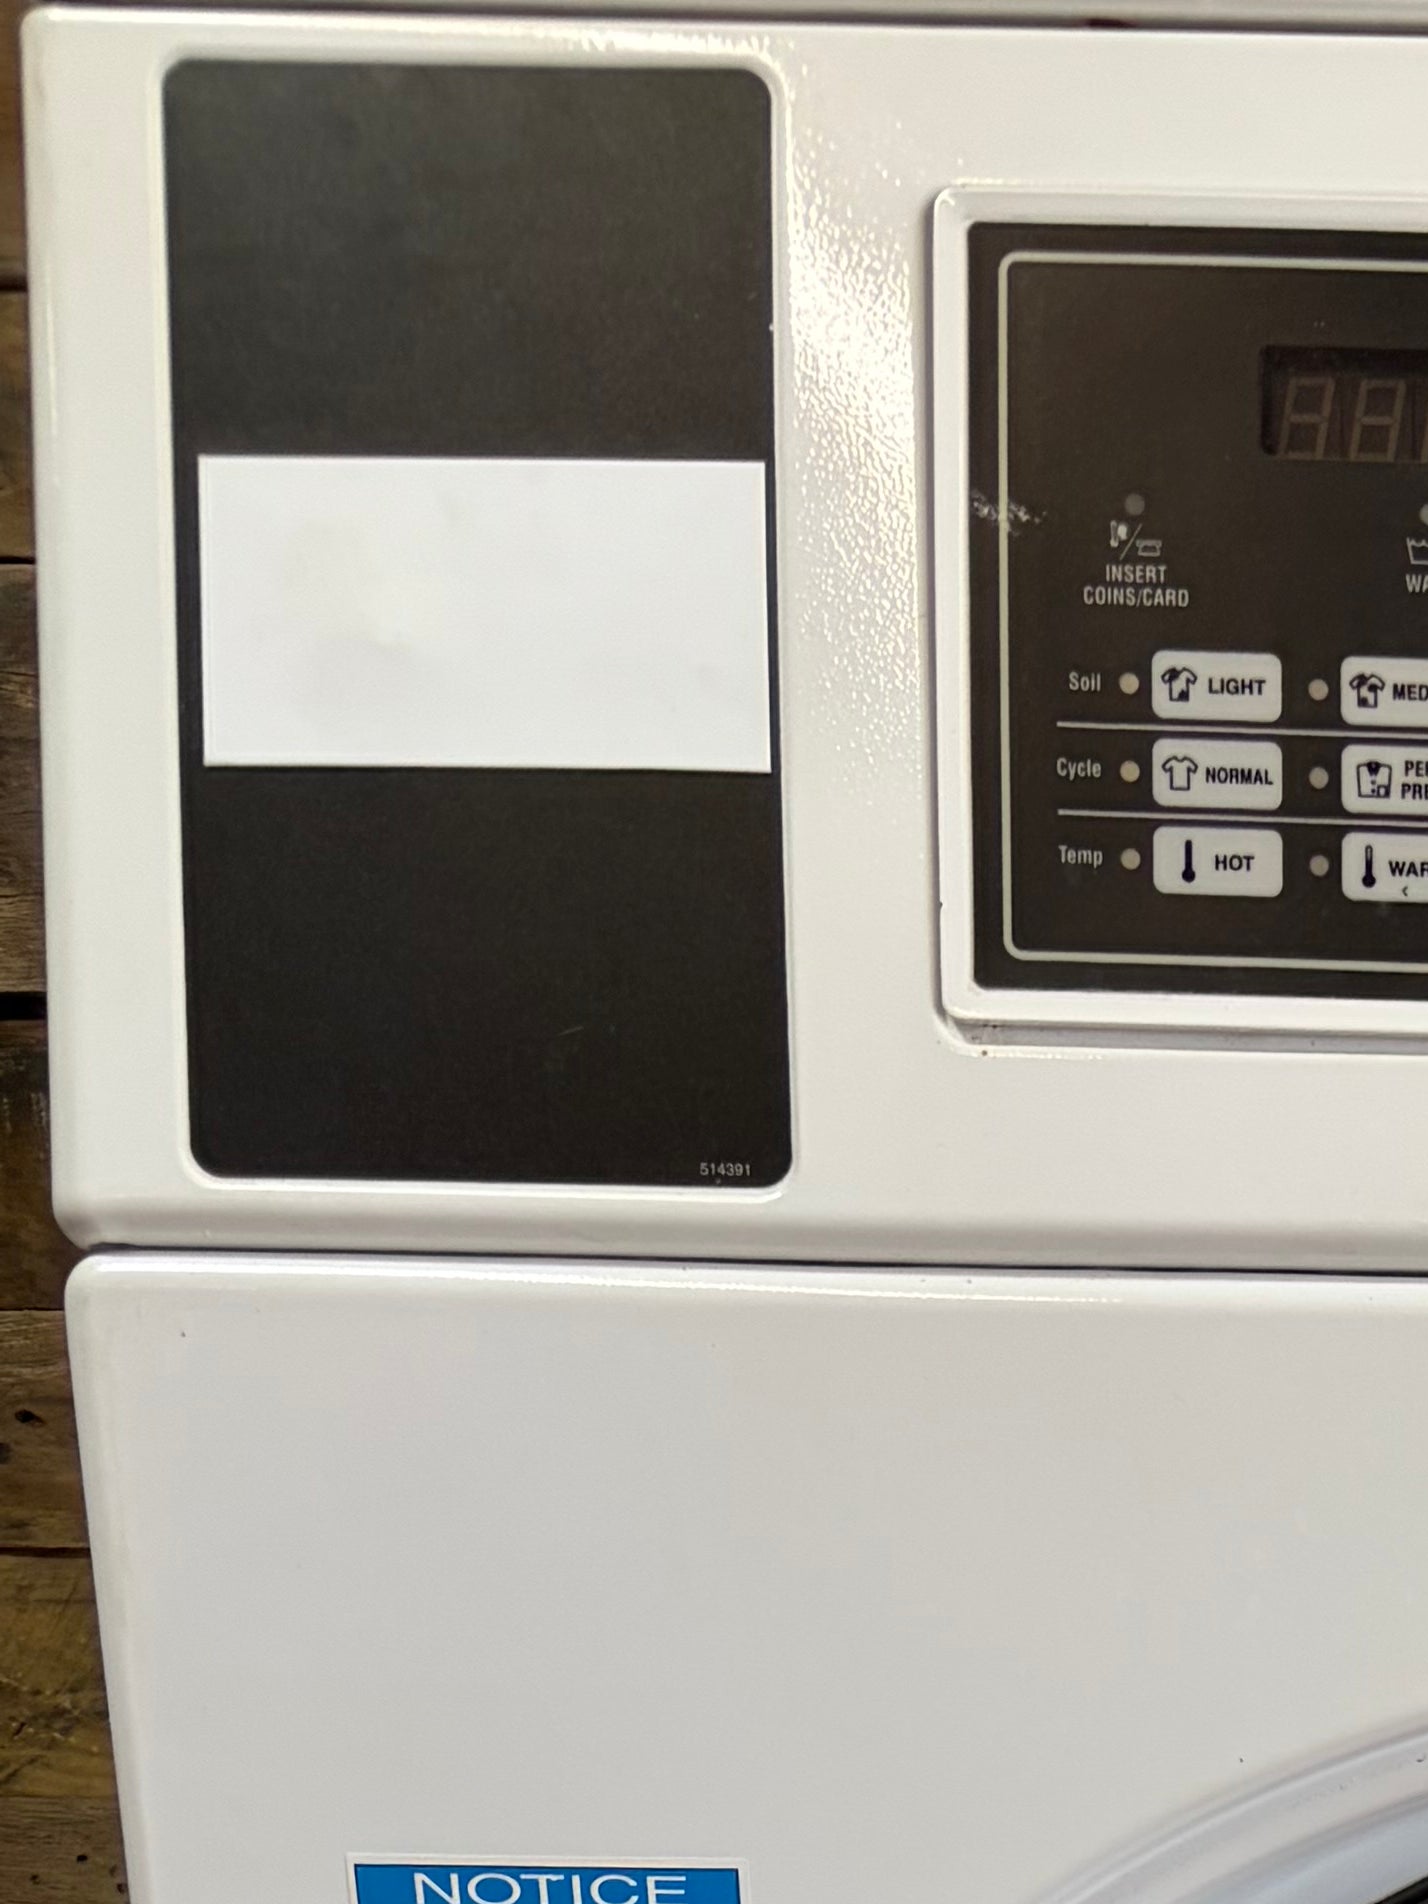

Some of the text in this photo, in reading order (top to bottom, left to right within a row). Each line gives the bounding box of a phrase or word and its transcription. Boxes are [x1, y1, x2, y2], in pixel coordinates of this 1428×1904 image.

[1106, 565, 1166, 583] INSERT
[1084, 586, 1188, 606] COINS/CARD
[1069, 672, 1100, 691] Soil
[1209, 678, 1266, 695] LIGHT
[1057, 758, 1101, 780] Cycle
[1206, 767, 1273, 785] NORMAL
[1059, 845, 1102, 868] Temp
[1215, 855, 1254, 871] HOT
[700, 1163, 750, 1176] 514391
